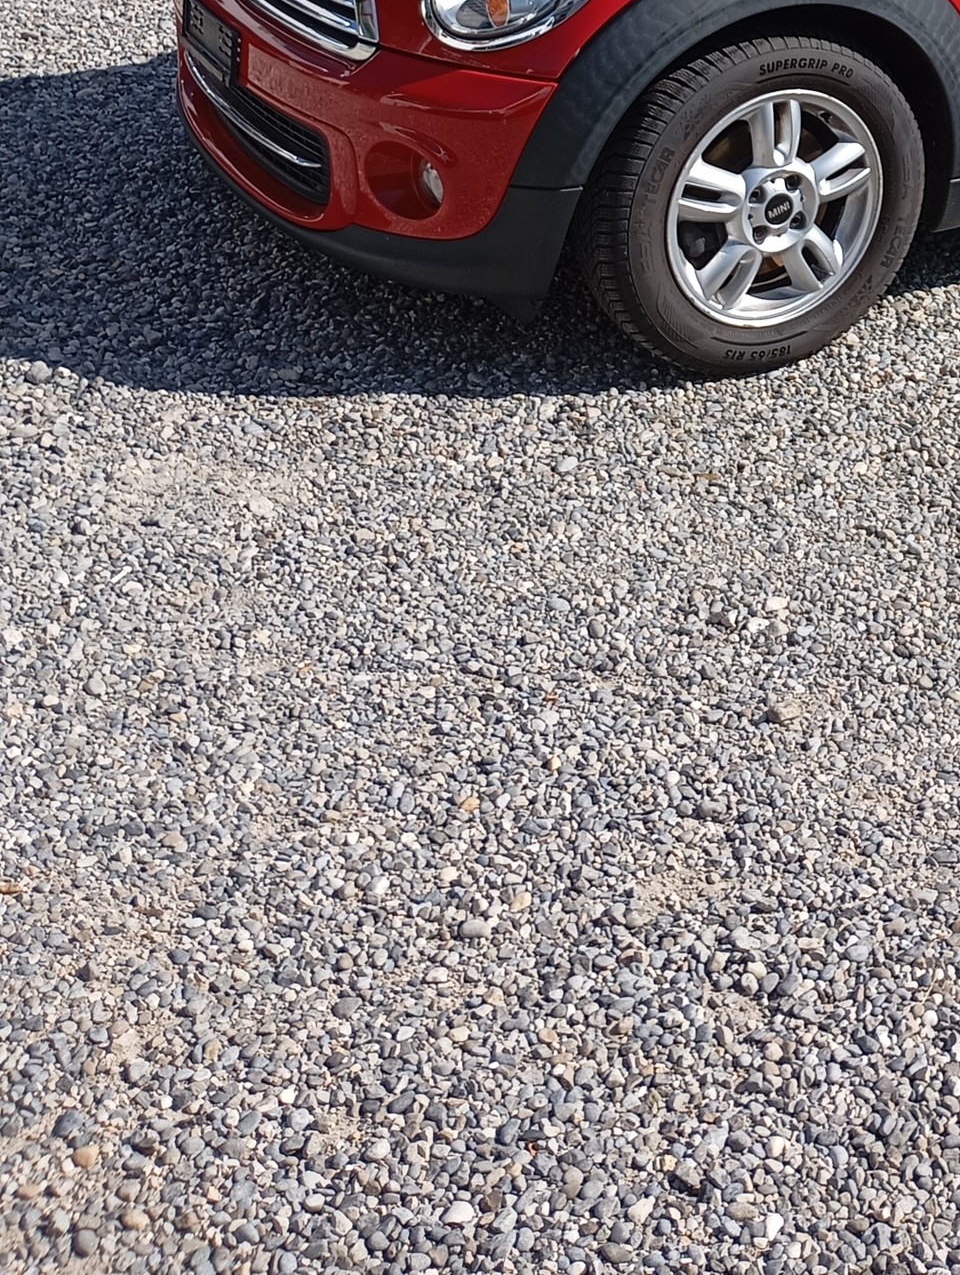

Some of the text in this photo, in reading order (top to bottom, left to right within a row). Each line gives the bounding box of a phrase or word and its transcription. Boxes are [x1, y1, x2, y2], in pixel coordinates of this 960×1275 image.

[759, 57, 854, 78] SUPERGRIP PRO
[767, 200, 791, 219] MINI
[723, 344, 791, 361] 185/65 R15
